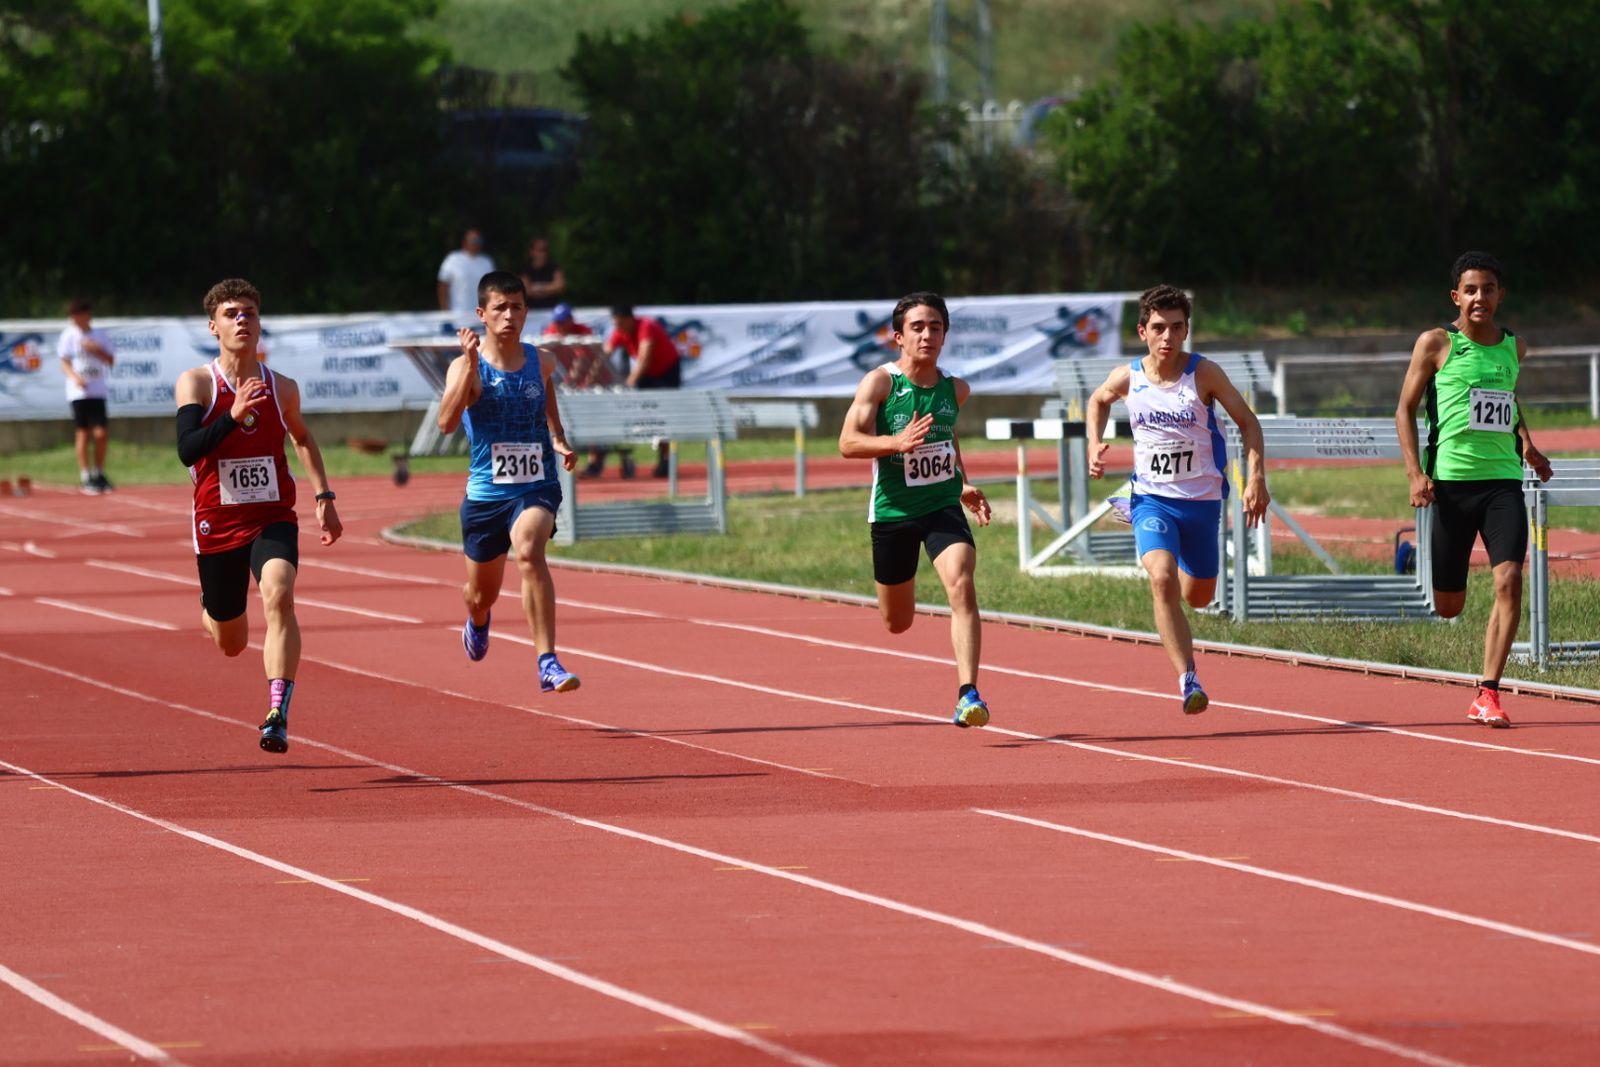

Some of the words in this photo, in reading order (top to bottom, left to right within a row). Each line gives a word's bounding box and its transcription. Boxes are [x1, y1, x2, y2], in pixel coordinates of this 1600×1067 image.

[1474, 401, 1511, 425] 1210
[496, 454, 540, 477] 2316
[909, 453, 953, 480] 3064
[1151, 450, 1194, 475] 4277
[229, 466, 270, 489] 1653
